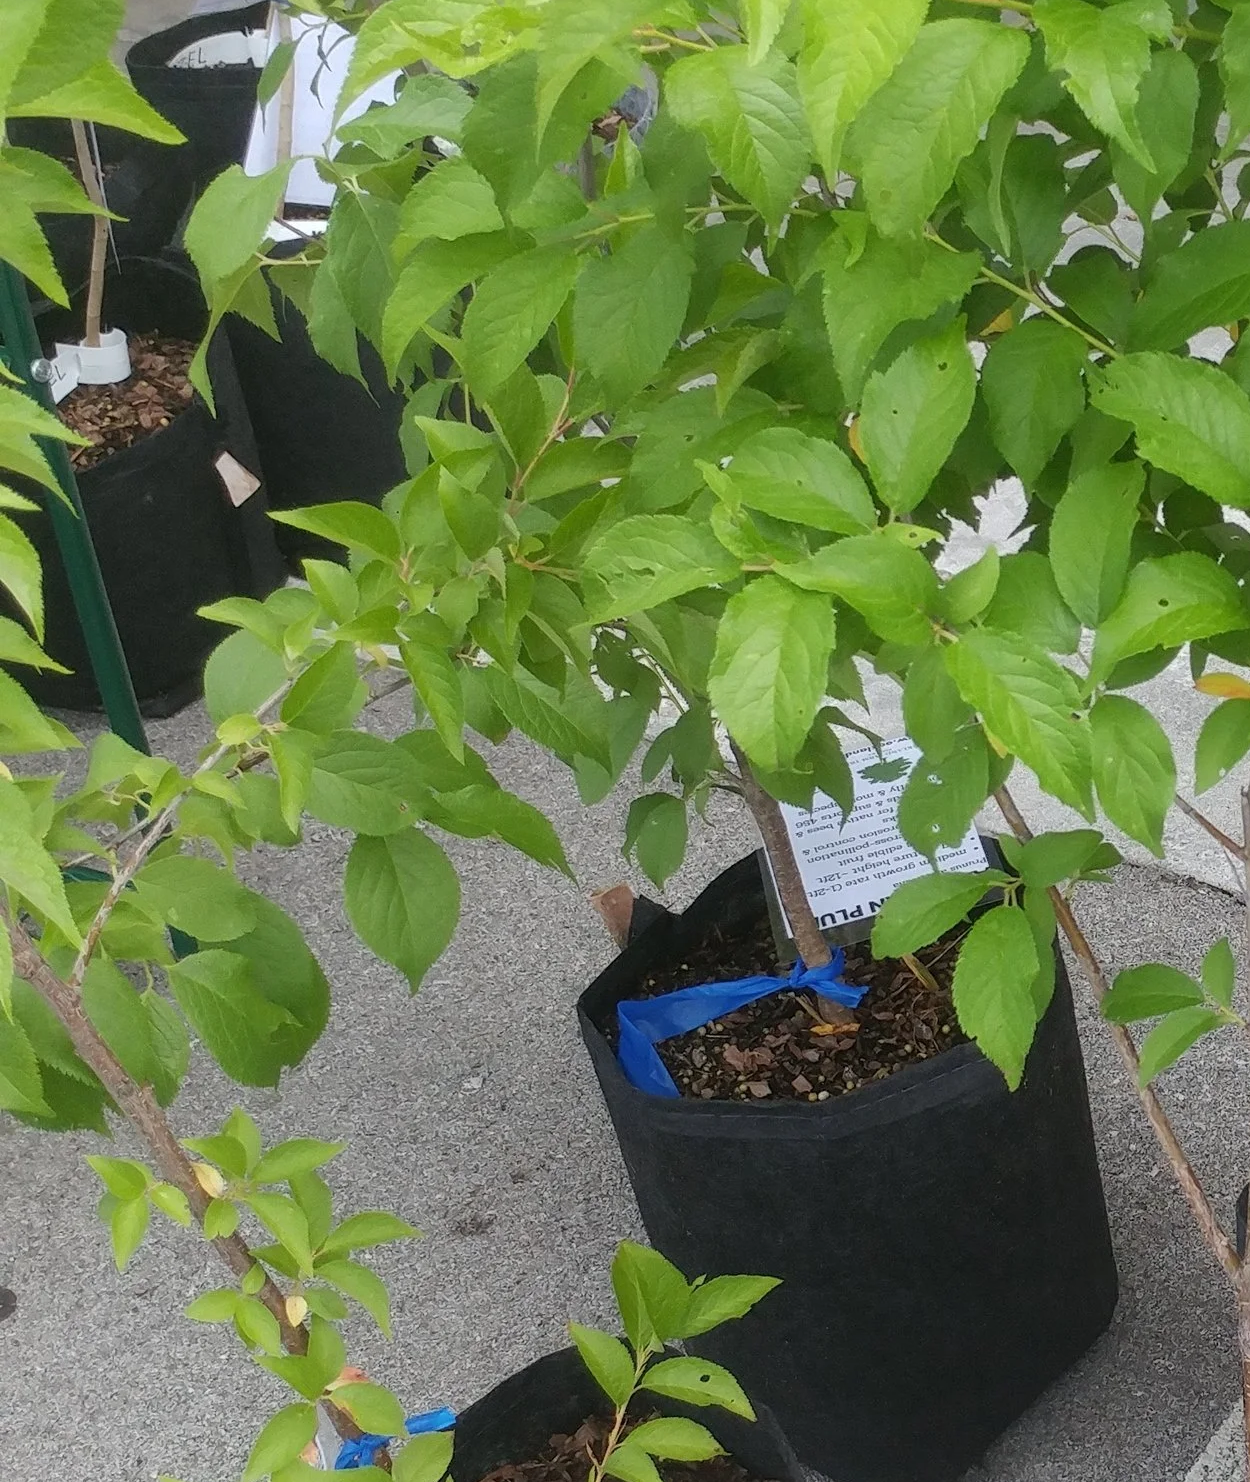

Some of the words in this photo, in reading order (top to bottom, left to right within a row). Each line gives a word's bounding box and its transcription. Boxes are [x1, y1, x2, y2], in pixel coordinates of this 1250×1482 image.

[798, 802, 837, 816] specs
[821, 803, 872, 821] suorts
[877, 807, 894, 815] for
[807, 823, 834, 834] bees
[814, 836, 856, 853] control
[867, 845, 903, 858] edible
[838, 855, 864, 867] fruit
[893, 852, 918, 863] ture
[919, 849, 966, 867] medim
[852, 859, 890, 874] height
[873, 862, 916, 880] growth
[845, 876, 869, 887] rate
[807, 883, 842, 898] (1-2ft
